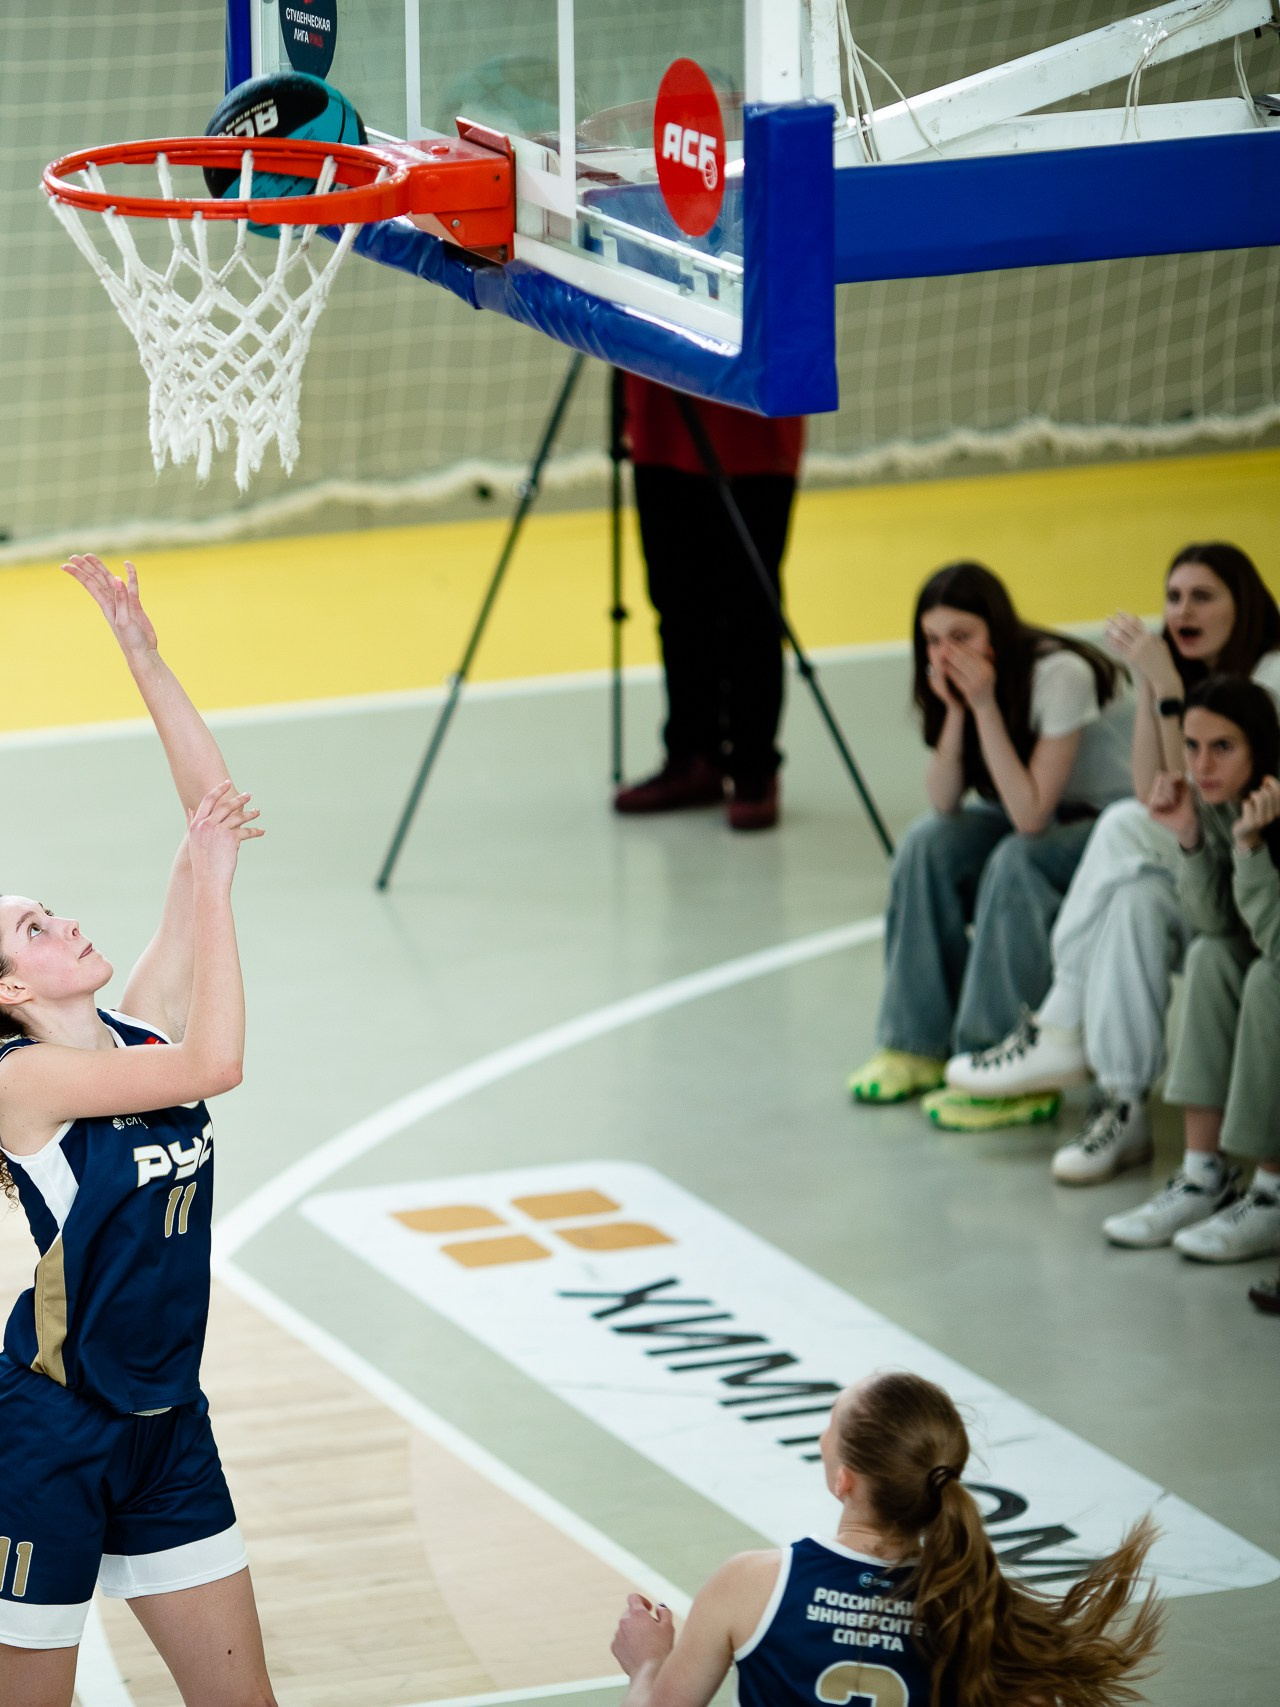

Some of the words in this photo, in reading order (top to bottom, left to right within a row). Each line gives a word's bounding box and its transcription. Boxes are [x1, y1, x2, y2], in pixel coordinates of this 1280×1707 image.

[285, 7, 331, 32] СТУДЕНЧЕСКАЯ
[293, 28, 309, 44] ЛИГА
[224, 104, 279, 137] АС
[662, 121, 718, 190] АСБ
[164, 1181, 197, 1238] 11
[813, 1587, 918, 1617] РОССИЙСКИ
[806, 1604, 927, 1636] УНИВЕРСИТЕ
[832, 1628, 904, 1652] СПОРТА
